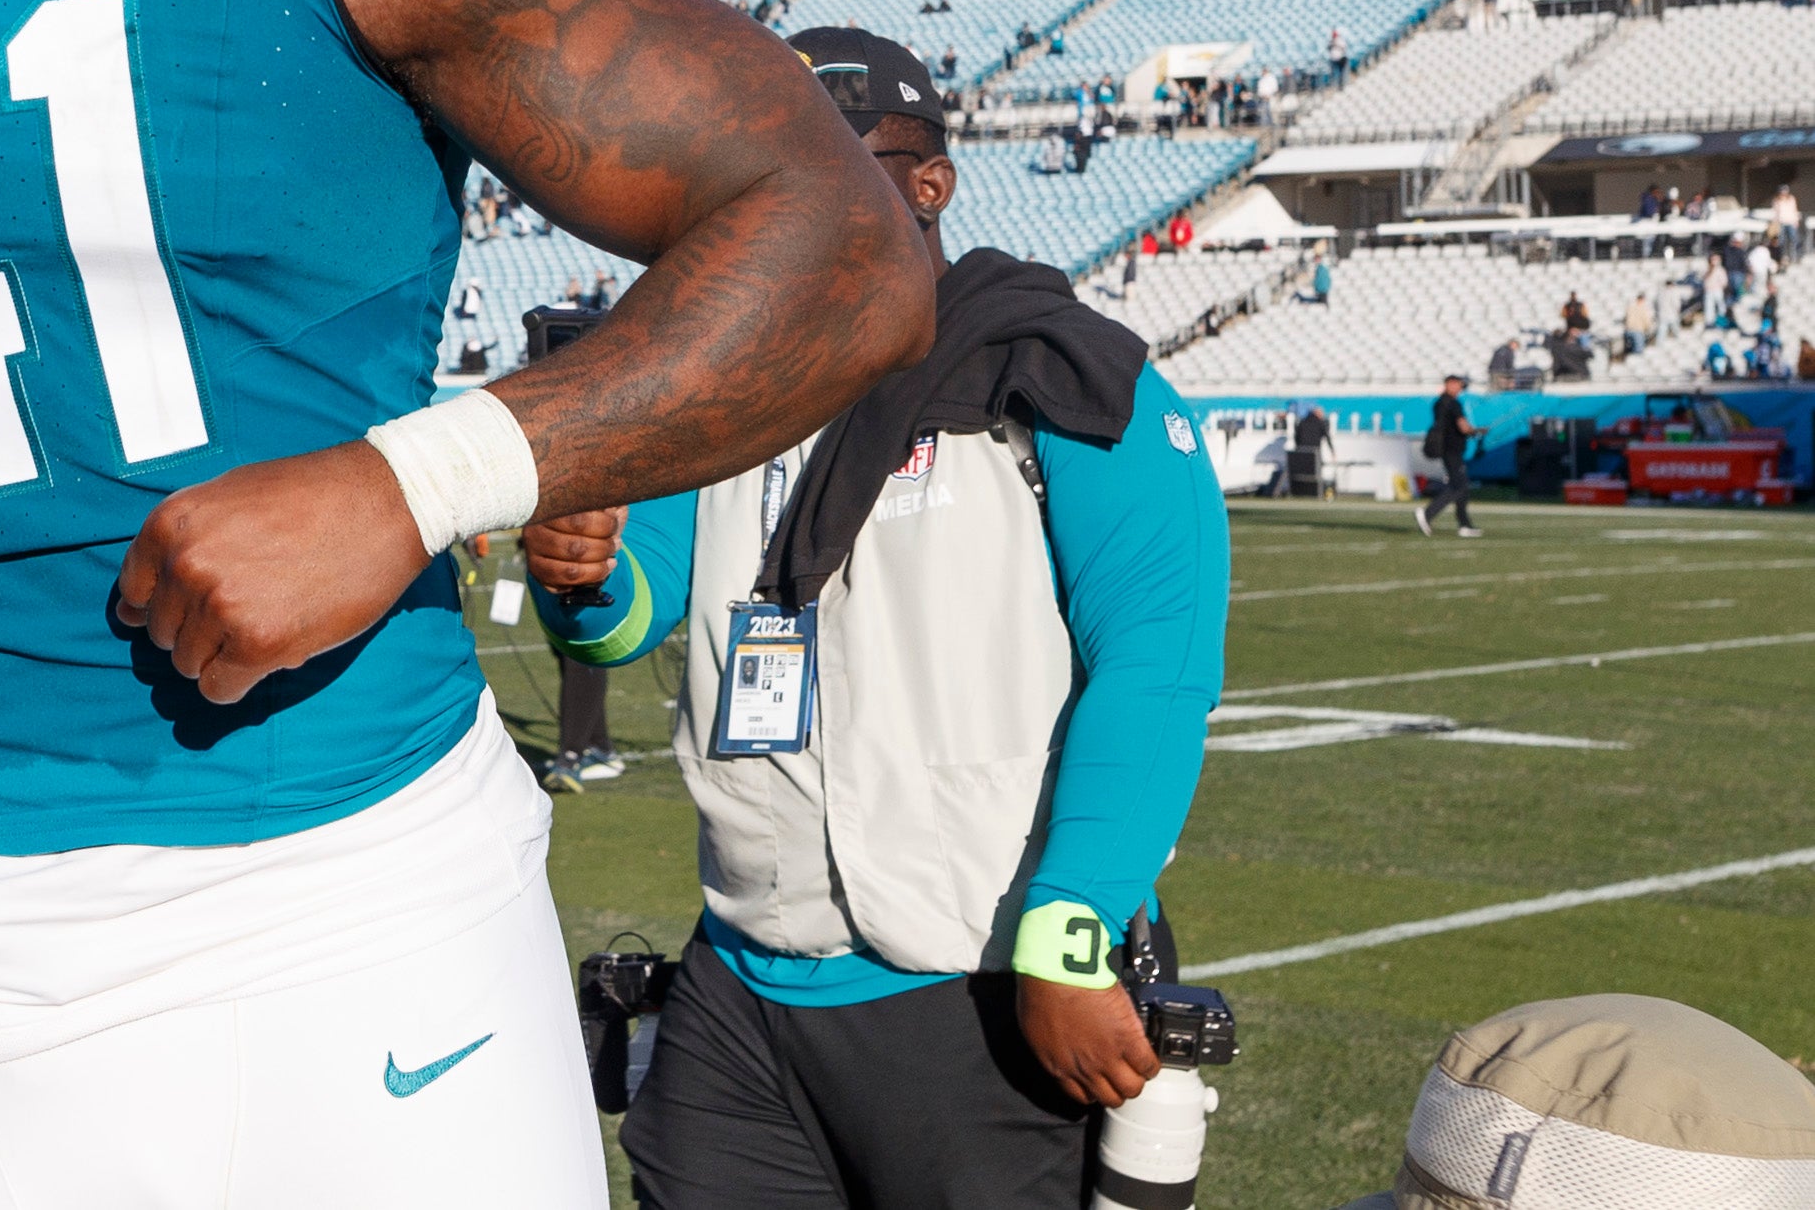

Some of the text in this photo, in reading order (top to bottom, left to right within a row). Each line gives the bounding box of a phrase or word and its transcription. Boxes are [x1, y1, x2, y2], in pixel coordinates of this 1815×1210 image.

[766, 469, 784, 533] JACKSONVILLE
[875, 483, 954, 522] MEDIA
[749, 616, 796, 636] 2023
